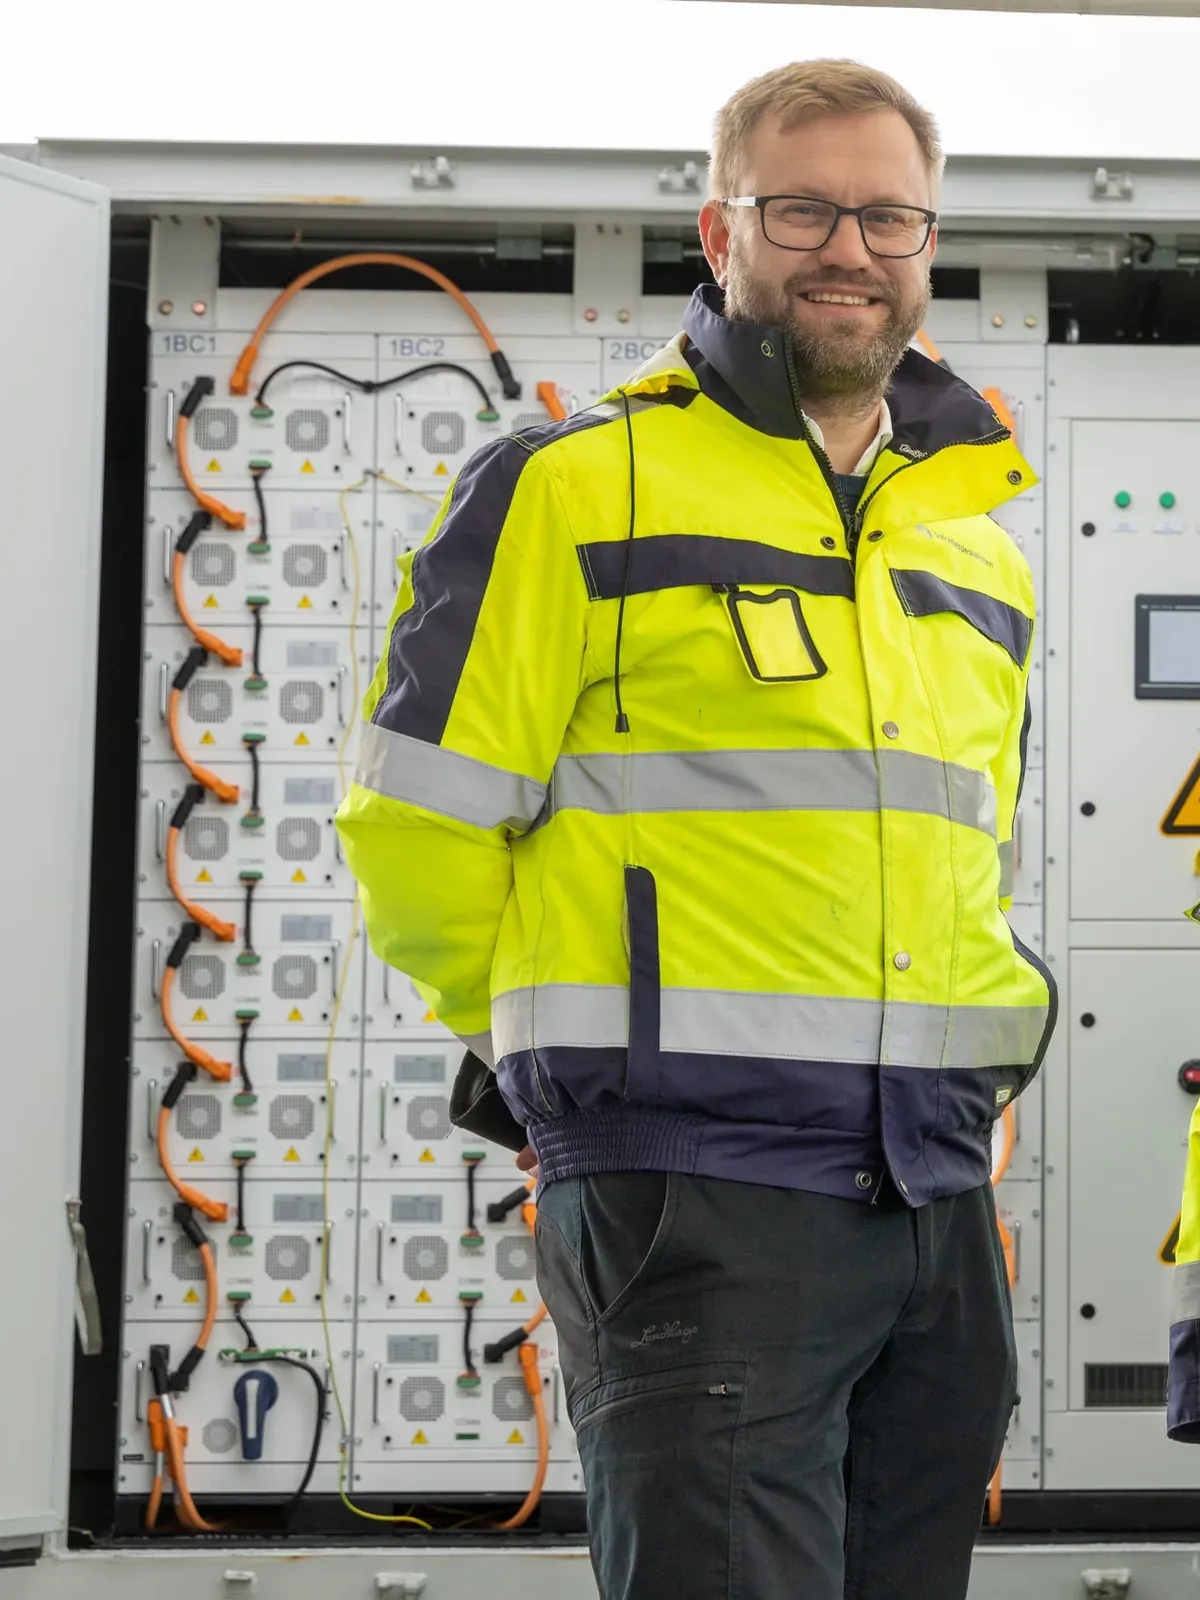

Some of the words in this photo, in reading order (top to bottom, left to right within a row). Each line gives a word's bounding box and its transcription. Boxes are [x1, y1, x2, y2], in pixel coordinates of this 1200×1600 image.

[162, 334, 216, 353] 1BC1
[390, 338, 446, 357] 1BC2
[610, 341, 666, 360] 2BC
